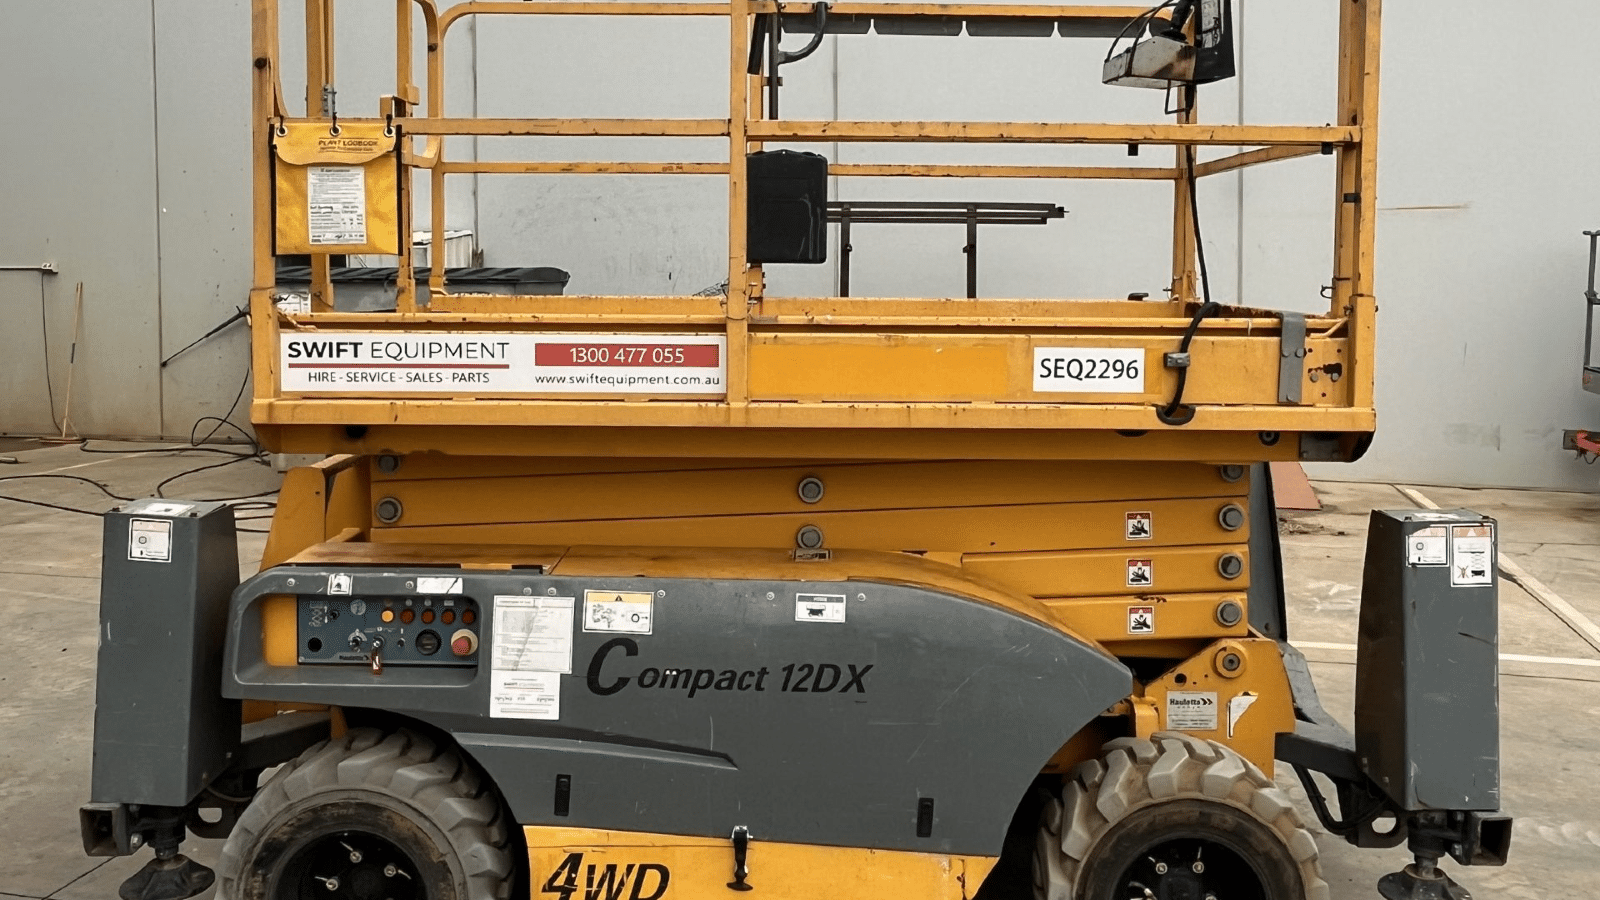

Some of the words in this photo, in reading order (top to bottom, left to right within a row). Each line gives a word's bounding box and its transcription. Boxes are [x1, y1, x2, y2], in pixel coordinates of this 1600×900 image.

[288, 341, 363, 359] SWIFT
[370, 342, 510, 362] EQUIPMENT
[569, 347, 610, 364] 1300
[614, 348, 648, 364] 477
[652, 348, 685, 364] 055
[308, 371, 337, 383] HIRE
[346, 371, 396, 383] SERVICE
[405, 372, 443, 383] SALES
[452, 372, 490, 383] PARTS
[535, 373, 720, 387] www.swiftequipment.com.au
[1040, 358, 1139, 381] SEQ2296
[586, 637, 769, 698] Compact
[780, 663, 874, 693] 12DX
[541, 852, 670, 900] 4WD
